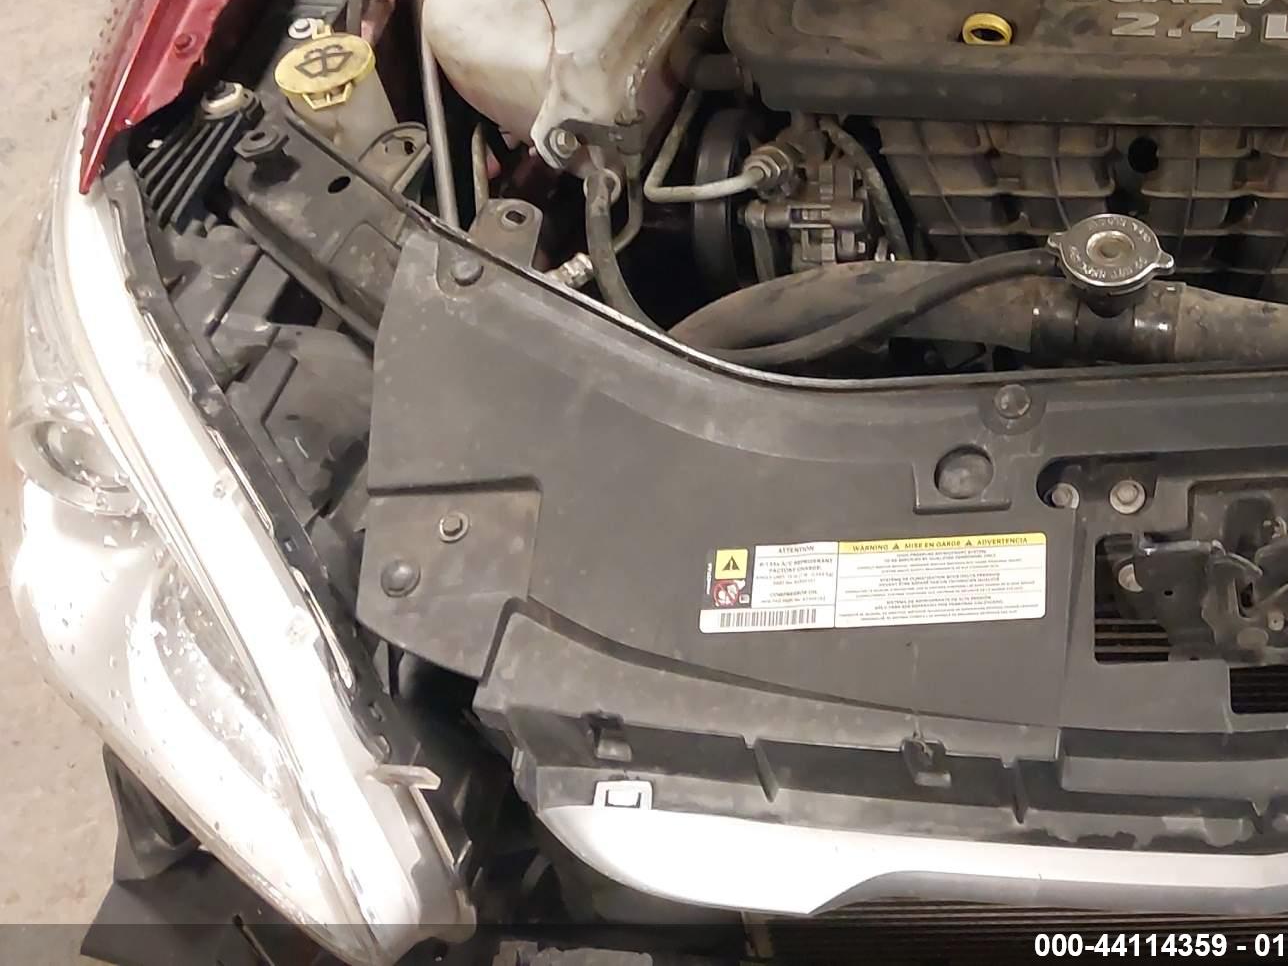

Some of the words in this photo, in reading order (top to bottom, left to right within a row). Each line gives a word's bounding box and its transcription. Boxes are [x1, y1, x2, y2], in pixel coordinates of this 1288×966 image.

[1111, 12, 1246, 39] 2.4
[852, 544, 889, 552] WARNING
[977, 537, 1028, 545] ADVERTENCIA
